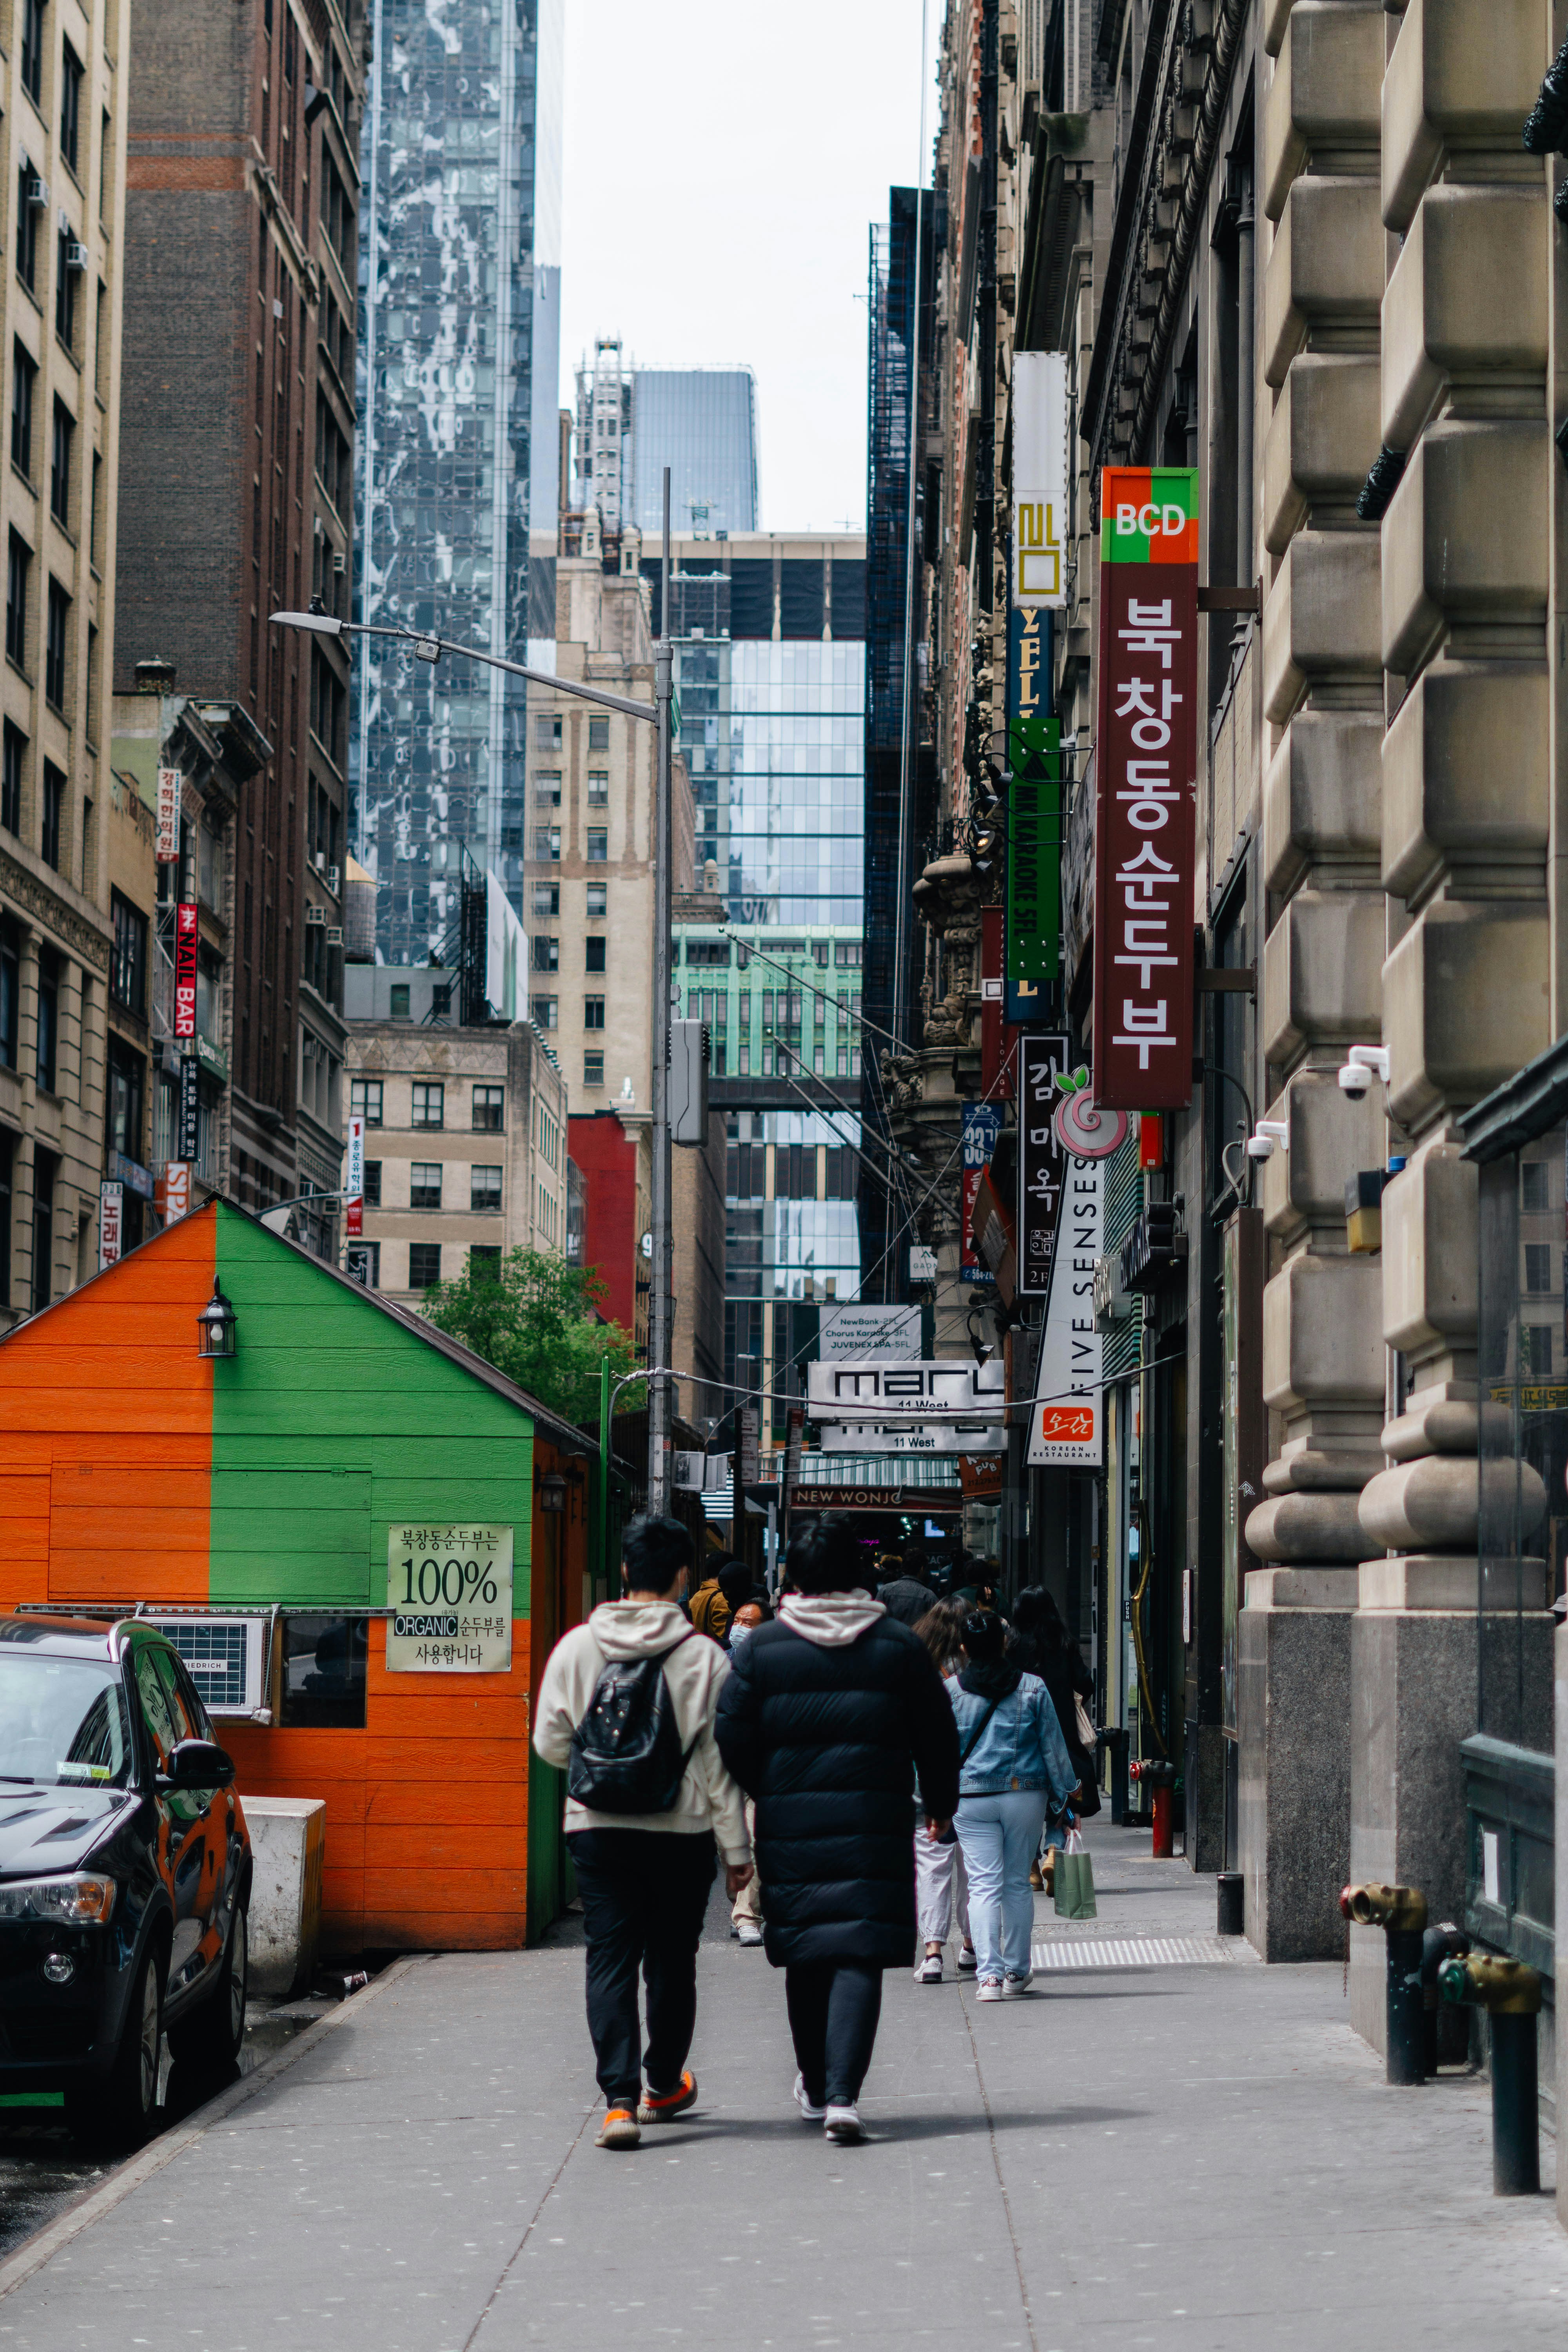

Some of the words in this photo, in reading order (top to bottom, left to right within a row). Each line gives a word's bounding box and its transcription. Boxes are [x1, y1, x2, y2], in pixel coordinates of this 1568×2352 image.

[1117, 504, 1186, 536] BCD
[1113, 599, 1182, 1069] 북창동순두부
[1014, 820, 1038, 902] KARAOKE
[1014, 908, 1037, 936] 5FL
[178, 932, 195, 984] NAIL
[176, 987, 194, 1034] BAR
[103, 1198, 119, 1265] 노래방
[1073, 1158, 1097, 1296] SENSES
[1071, 1319, 1095, 1396] FIVE
[898, 1401, 911, 1412] 11
[915, 1400, 949, 1412] West
[894, 1437, 906, 1447] 11
[908, 1437, 935, 1448] West
[975, 1461, 997, 1476] PUB
[797, 1490, 836, 1503] NEW
[839, 1490, 903, 1505] WONJO
[400, 1530, 499, 1551] 북창동순두부는
[401, 1558, 497, 1606] 100%
[395, 1616, 456, 1636] ORGANIC
[459, 1617, 506, 1637] 순두부를
[415, 1644, 483, 1666] 사용합니다
